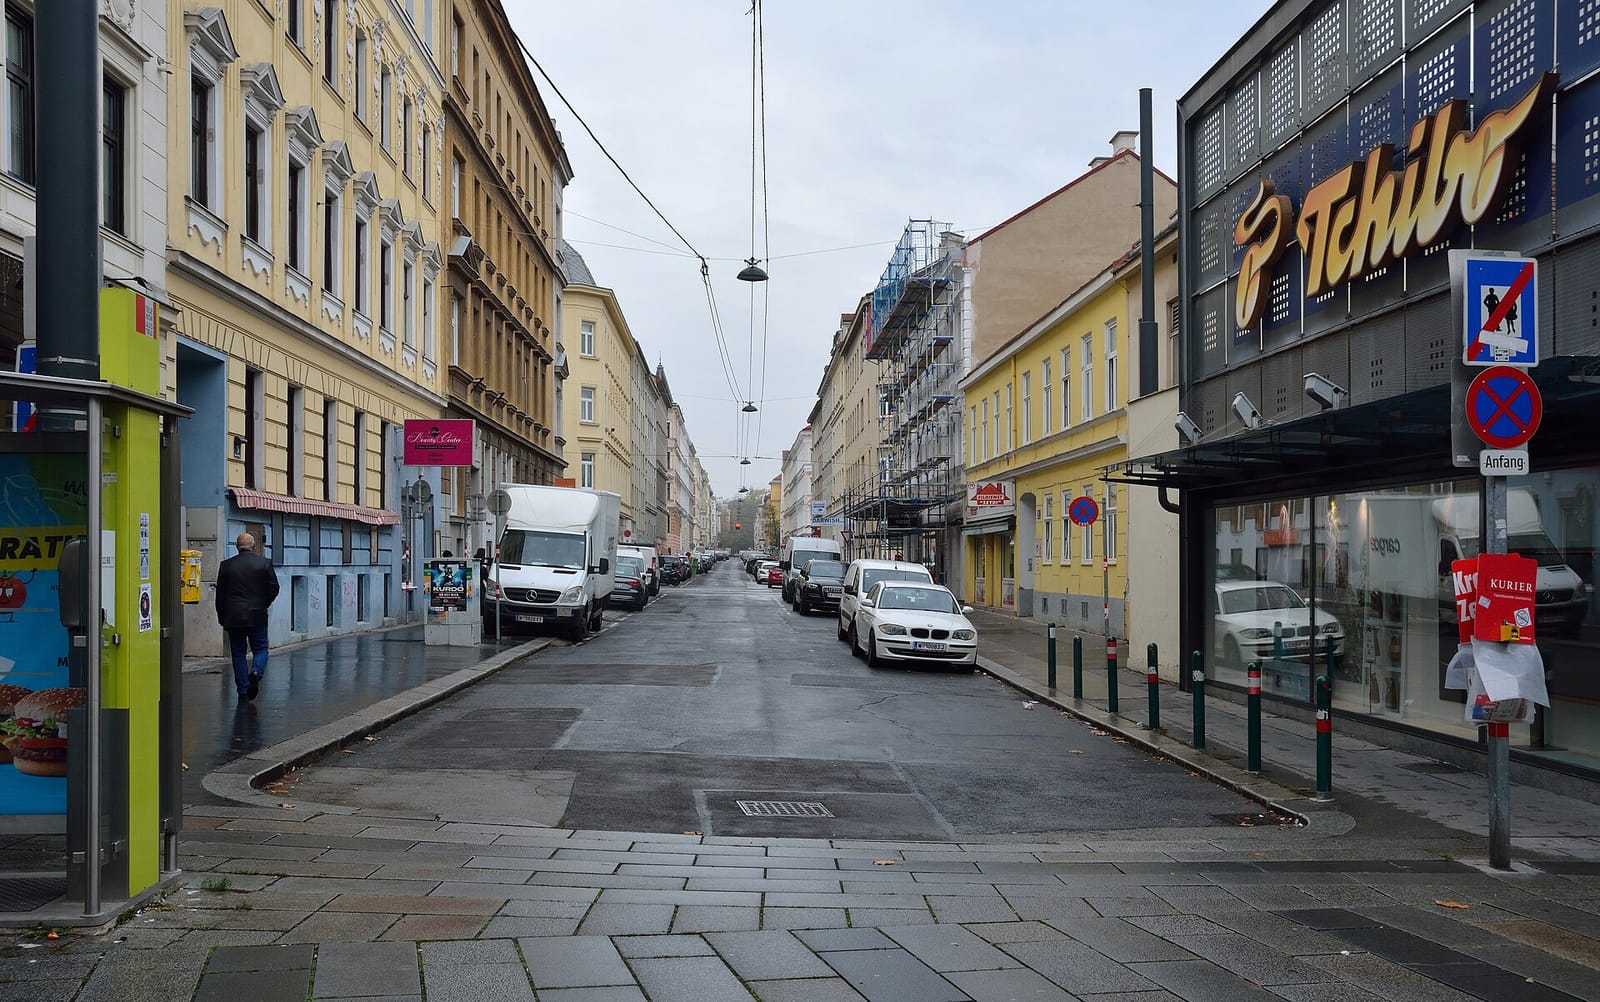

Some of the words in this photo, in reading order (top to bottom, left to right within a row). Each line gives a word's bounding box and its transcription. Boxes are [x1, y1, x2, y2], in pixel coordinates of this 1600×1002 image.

[1296, 72, 1559, 298] Tchibo
[407, 432, 436, 444] Beauty
[437, 432, 462, 444] Center
[1485, 455, 1524, 471] Anfang
[1490, 579, 1533, 593] KURIER
[1456, 599, 1477, 623] Ze
